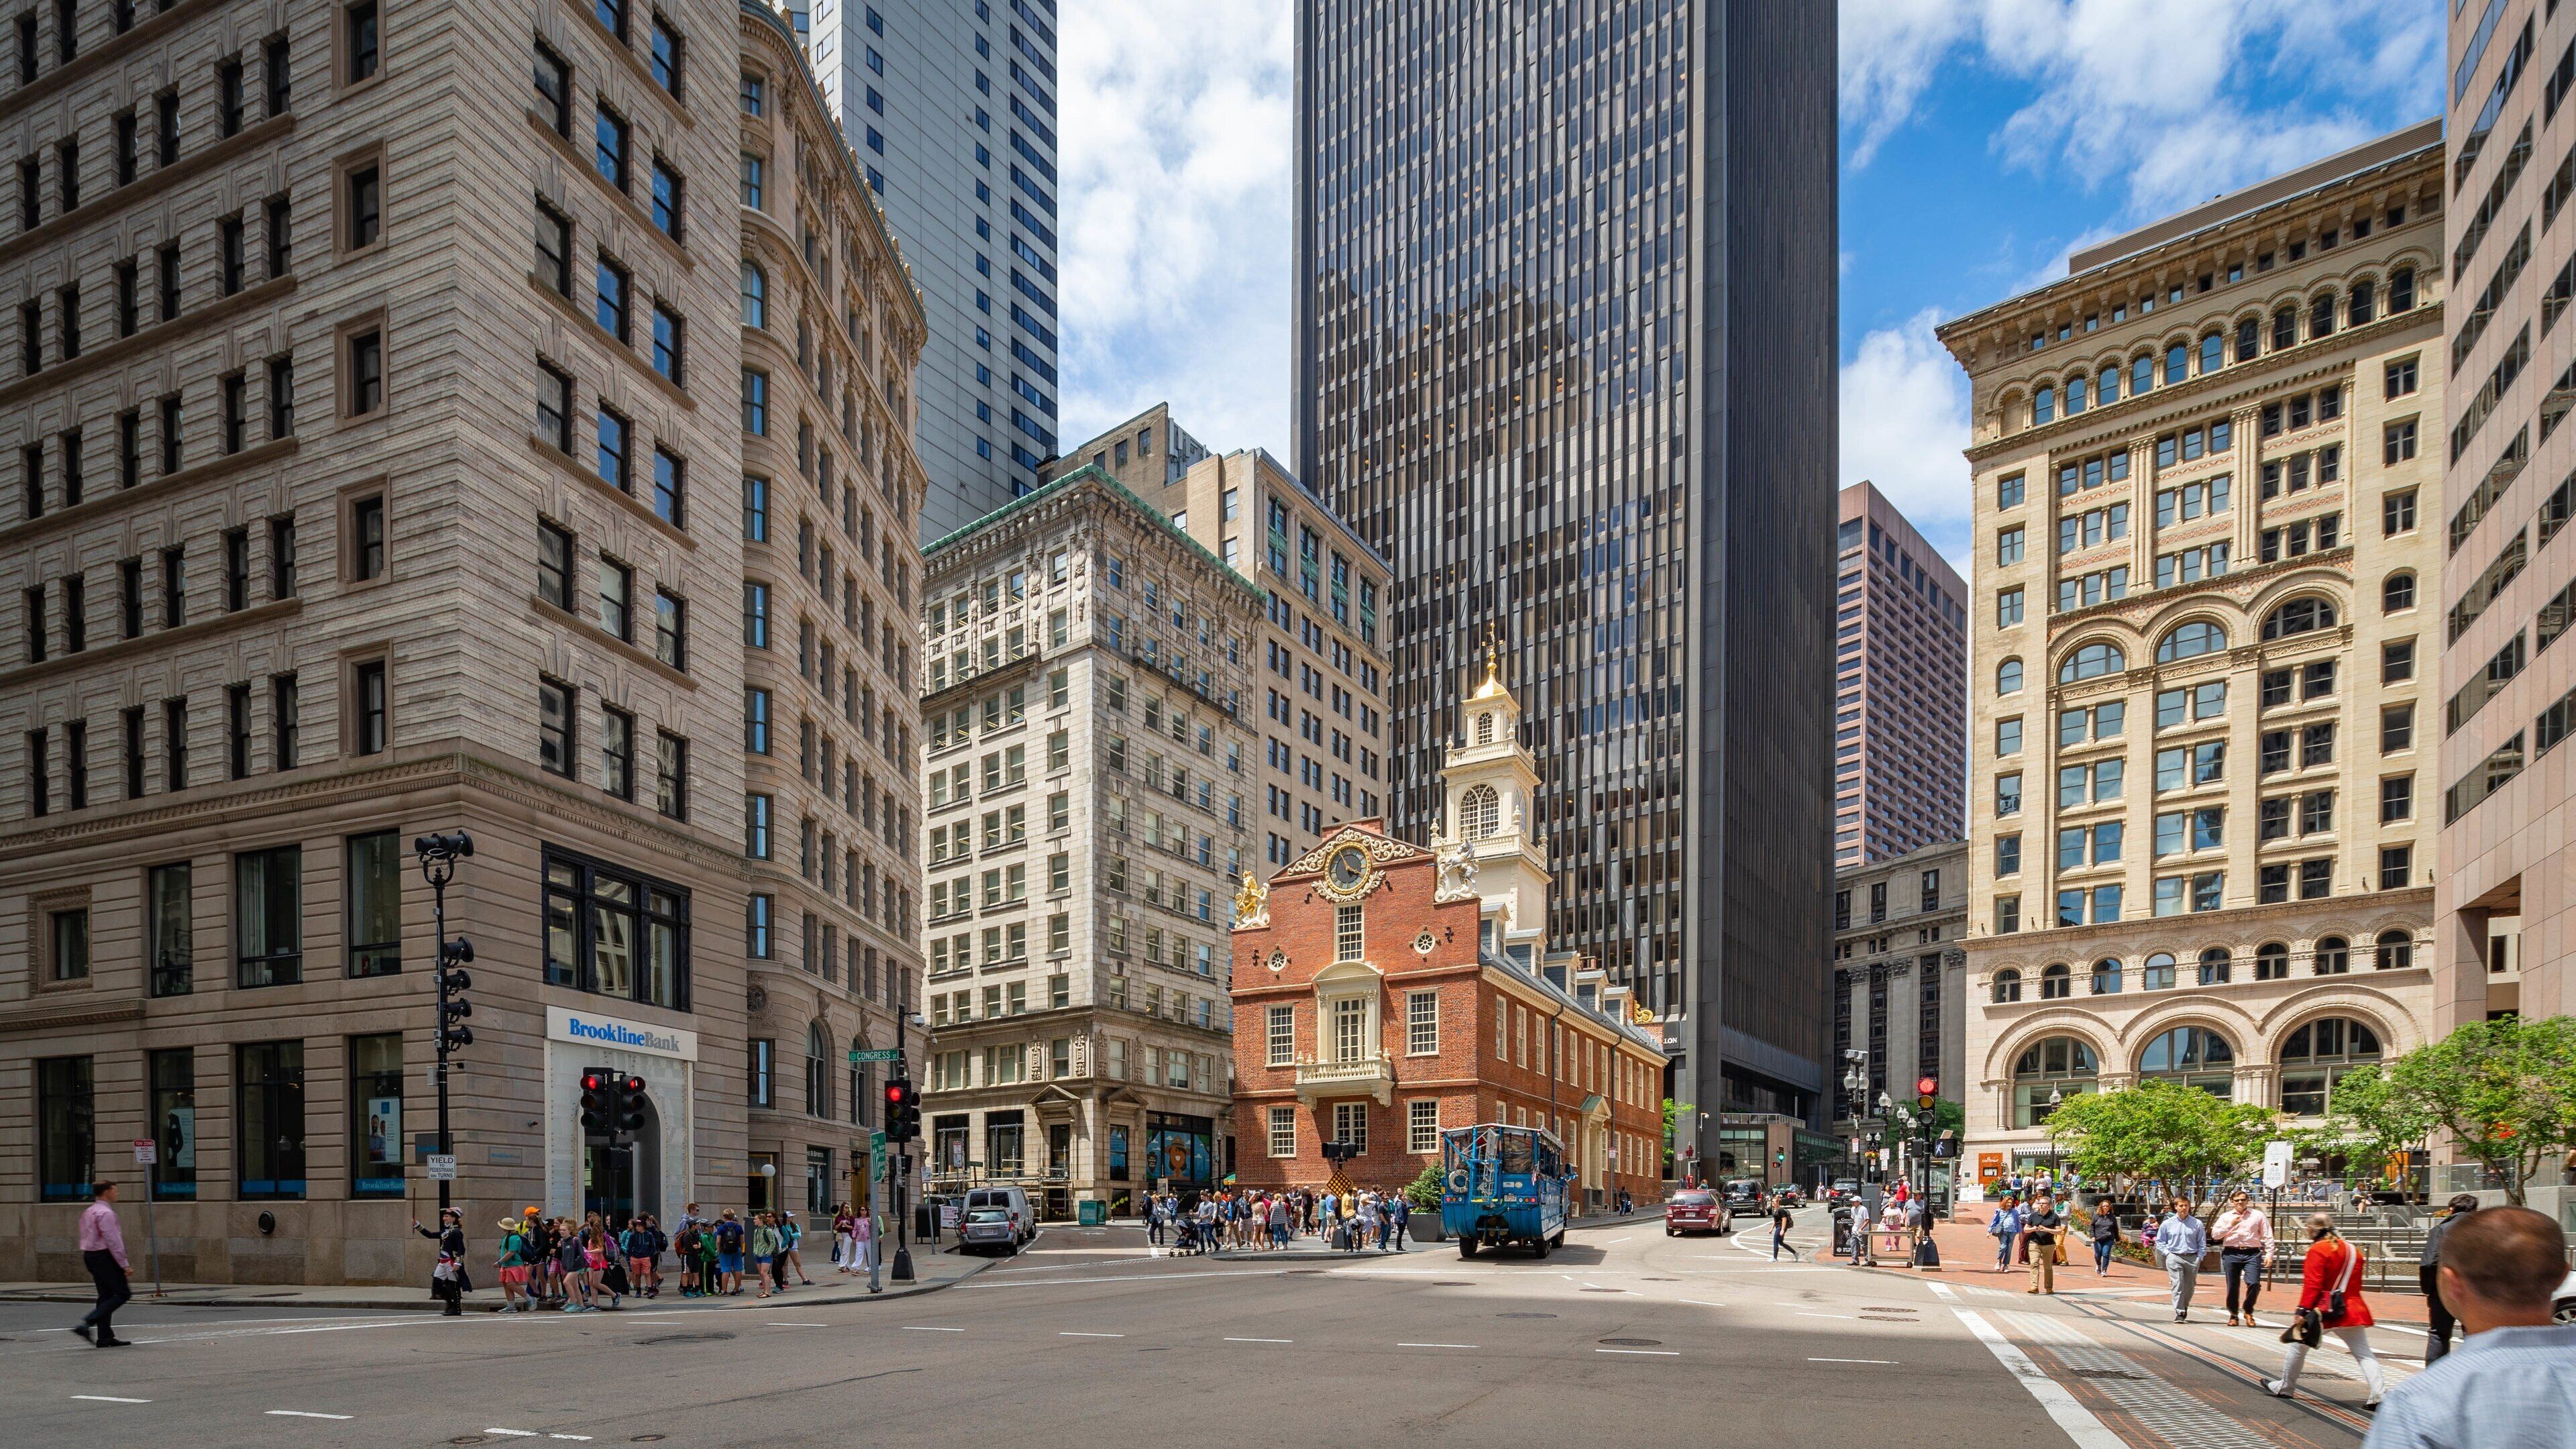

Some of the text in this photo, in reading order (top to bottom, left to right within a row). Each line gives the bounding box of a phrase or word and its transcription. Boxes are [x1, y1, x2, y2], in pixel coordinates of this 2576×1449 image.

[569, 1018, 680, 1052] BrooklineBank
[857, 1051, 890, 1060] CONGRESS
[362, 1180, 405, 1189] BrooklineBank
